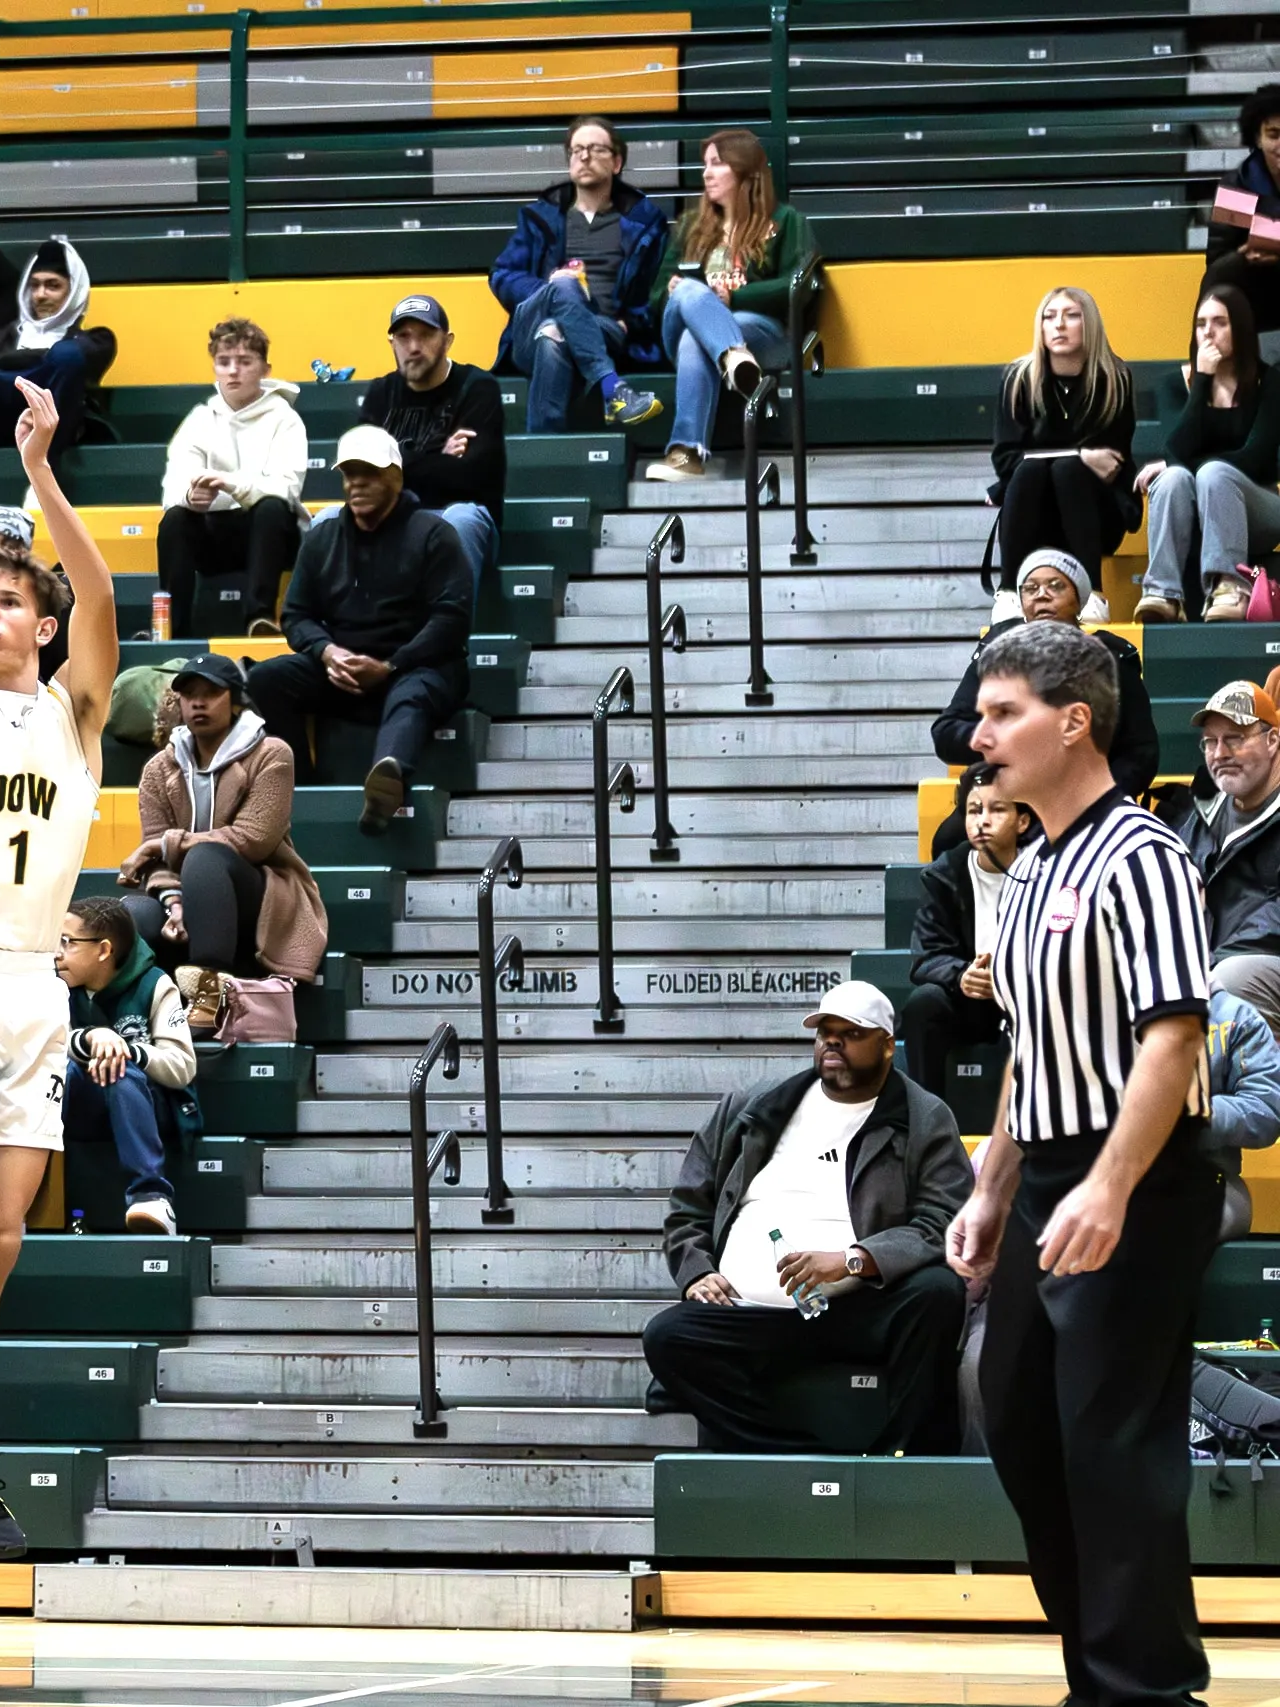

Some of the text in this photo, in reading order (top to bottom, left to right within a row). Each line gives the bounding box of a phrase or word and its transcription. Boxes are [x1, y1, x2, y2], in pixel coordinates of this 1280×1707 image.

[8, 830, 29, 885] 1
[392, 973, 429, 994] DO
[436, 973, 480, 994] NO
[646, 973, 723, 994] FOLDED
[727, 971, 842, 994] BLEACHERS
[469, 1107, 476, 1116] E
[149, 1262, 161, 1271] 46
[372, 1303, 380, 1313] C
[95, 1370, 107, 1378] 46
[326, 1413, 334, 1422] B
[38, 1476, 49, 1484] 35
[819, 1485, 832, 1493] 36
[273, 1522, 282, 1531] A
